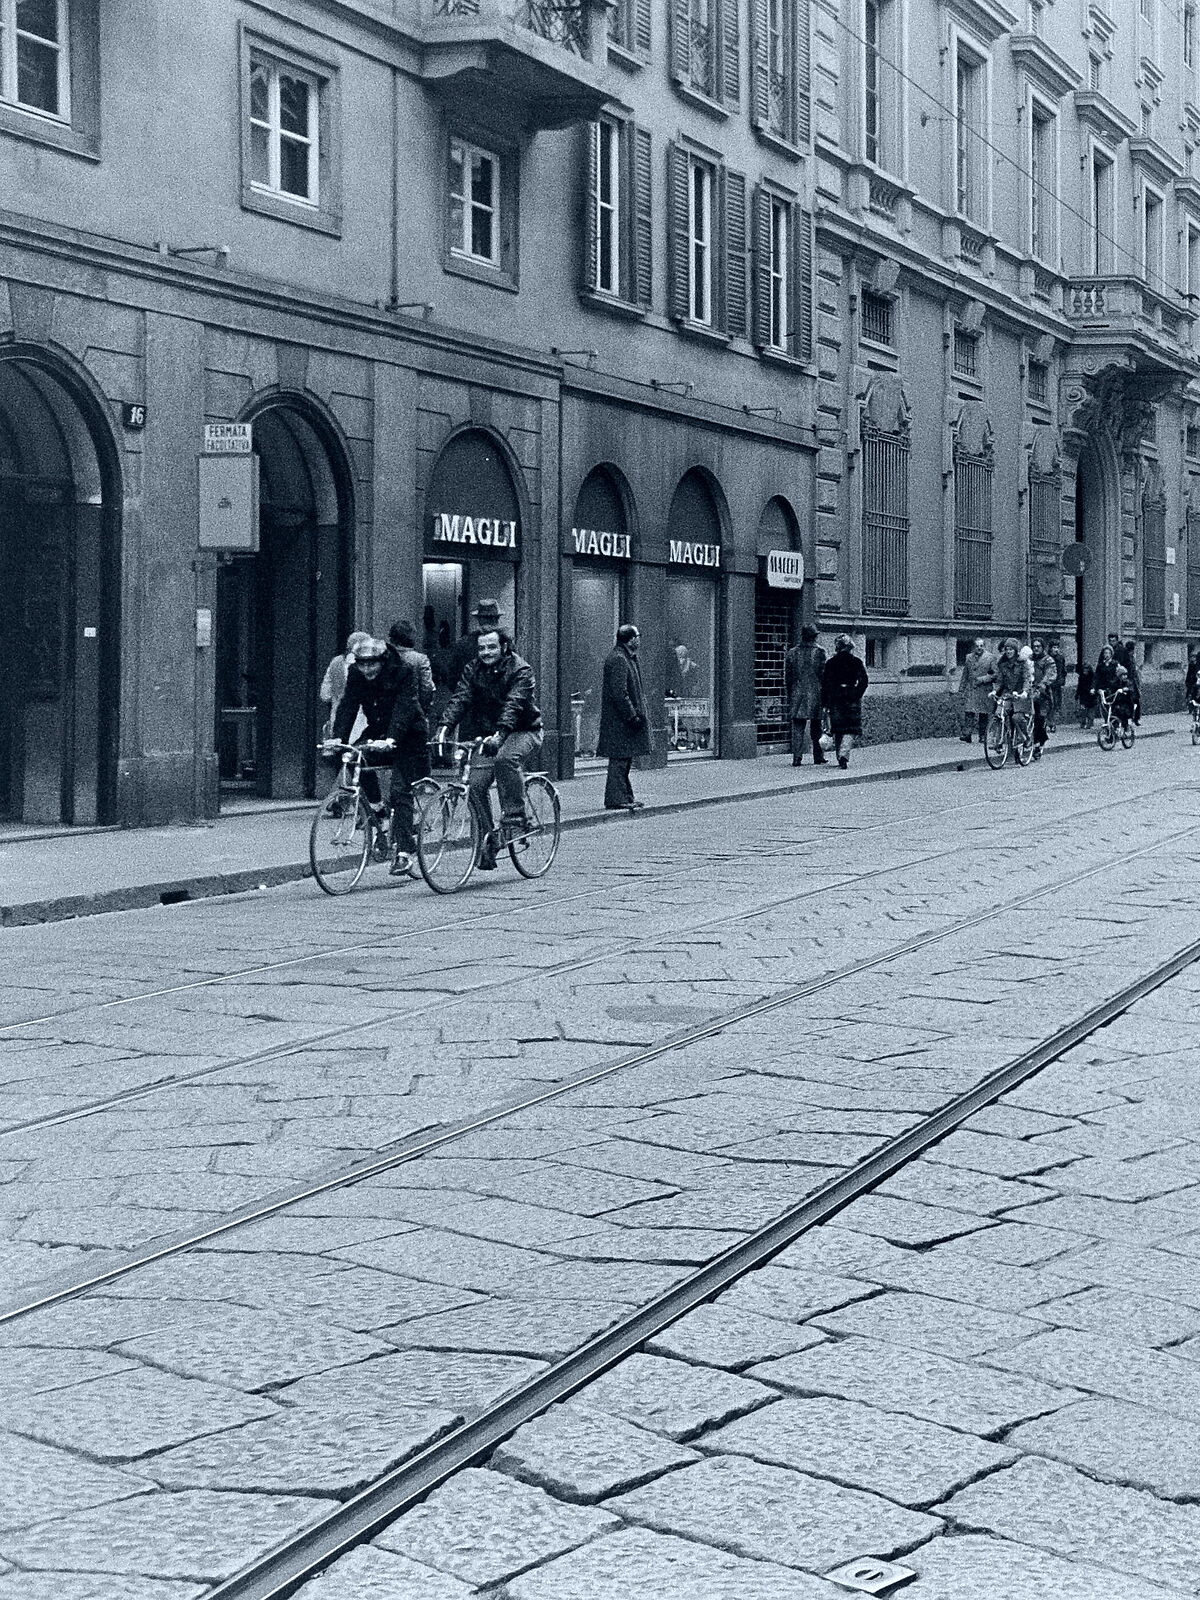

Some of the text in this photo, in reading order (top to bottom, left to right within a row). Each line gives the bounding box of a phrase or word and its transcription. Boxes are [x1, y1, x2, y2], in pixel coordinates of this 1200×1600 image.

[130, 406, 144, 424] 16
[209, 424, 247, 438] FERMATA
[439, 512, 517, 548] MAGLI
[571, 527, 632, 559] MAGLI
[669, 539, 721, 568] MAGLI
